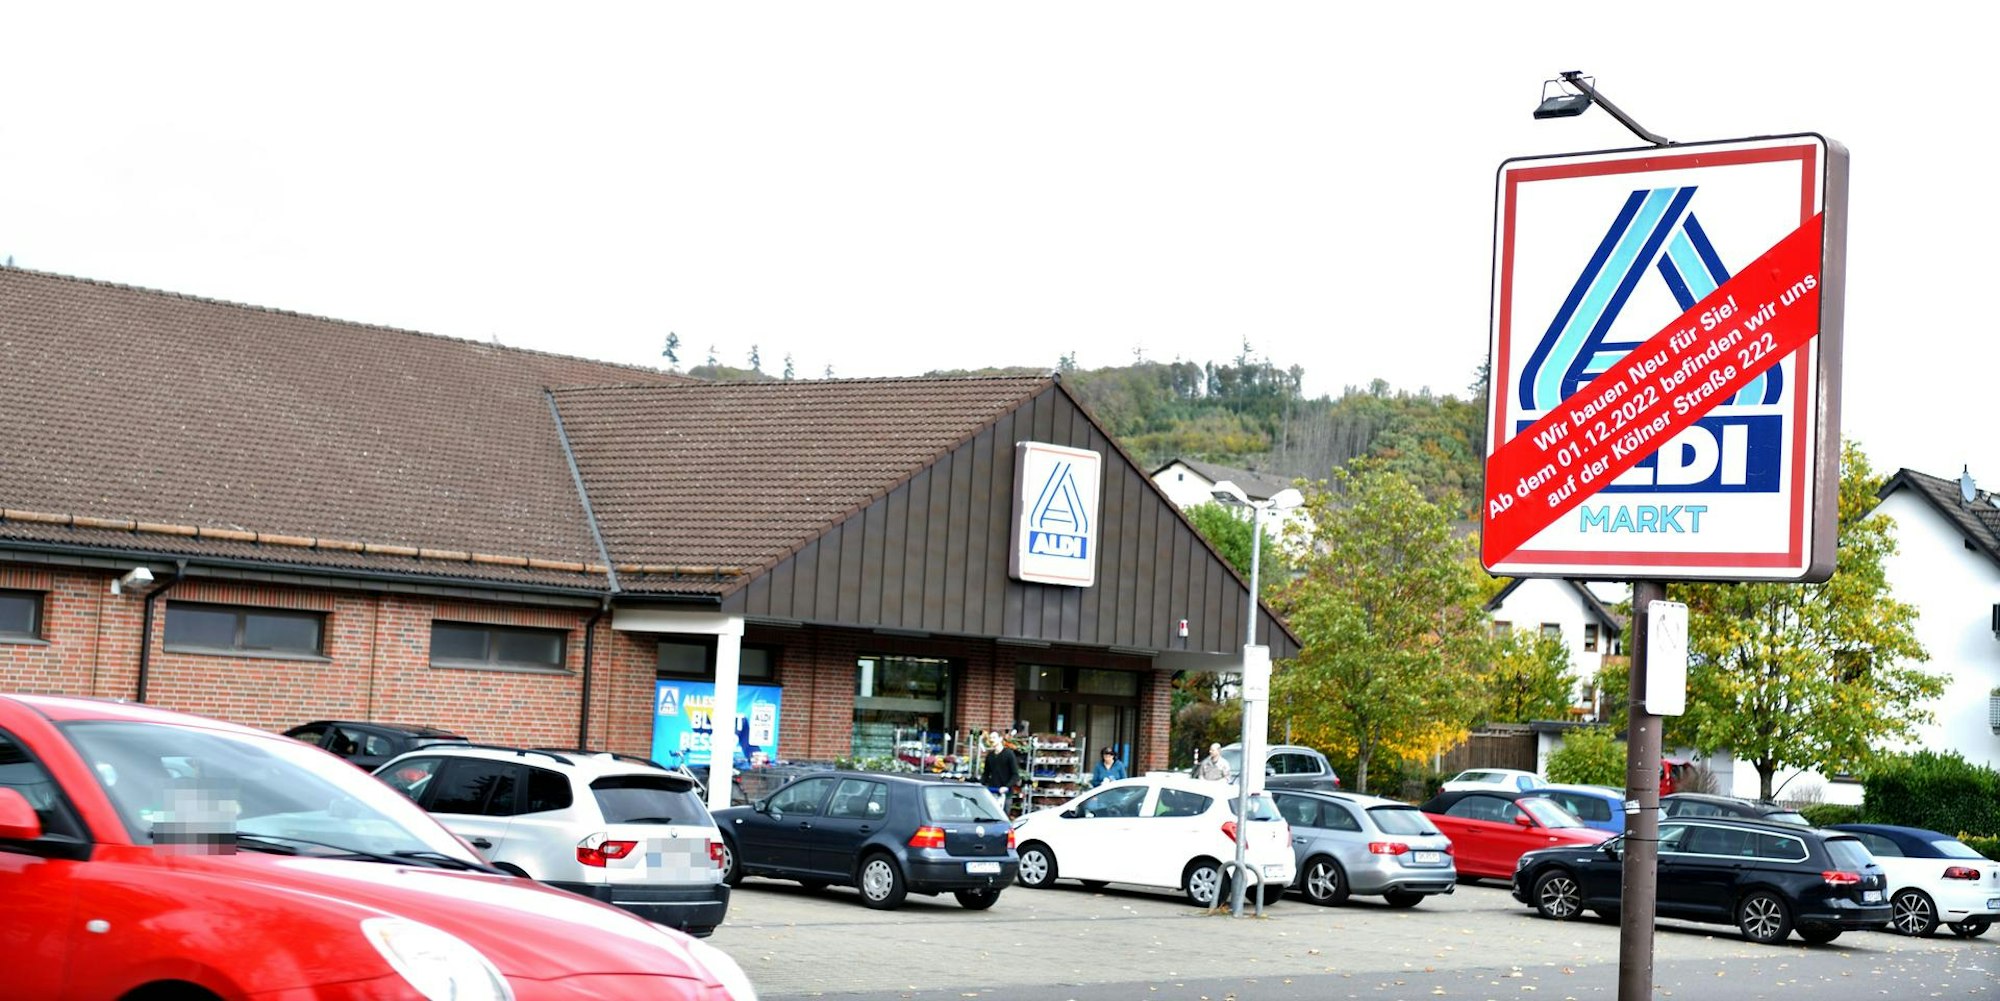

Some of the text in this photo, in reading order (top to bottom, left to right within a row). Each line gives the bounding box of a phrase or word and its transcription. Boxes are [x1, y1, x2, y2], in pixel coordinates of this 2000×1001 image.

[1488, 273, 1817, 519] Ab dem 01.12.2022 befinden wir uns
[1533, 295, 1739, 452] Wir bauen Neu für Sie!
[1547, 332, 1778, 508] auf der Kölner Straße 222
[1032, 532, 1081, 558] ALDI
[1580, 505, 1707, 533] MARKT
